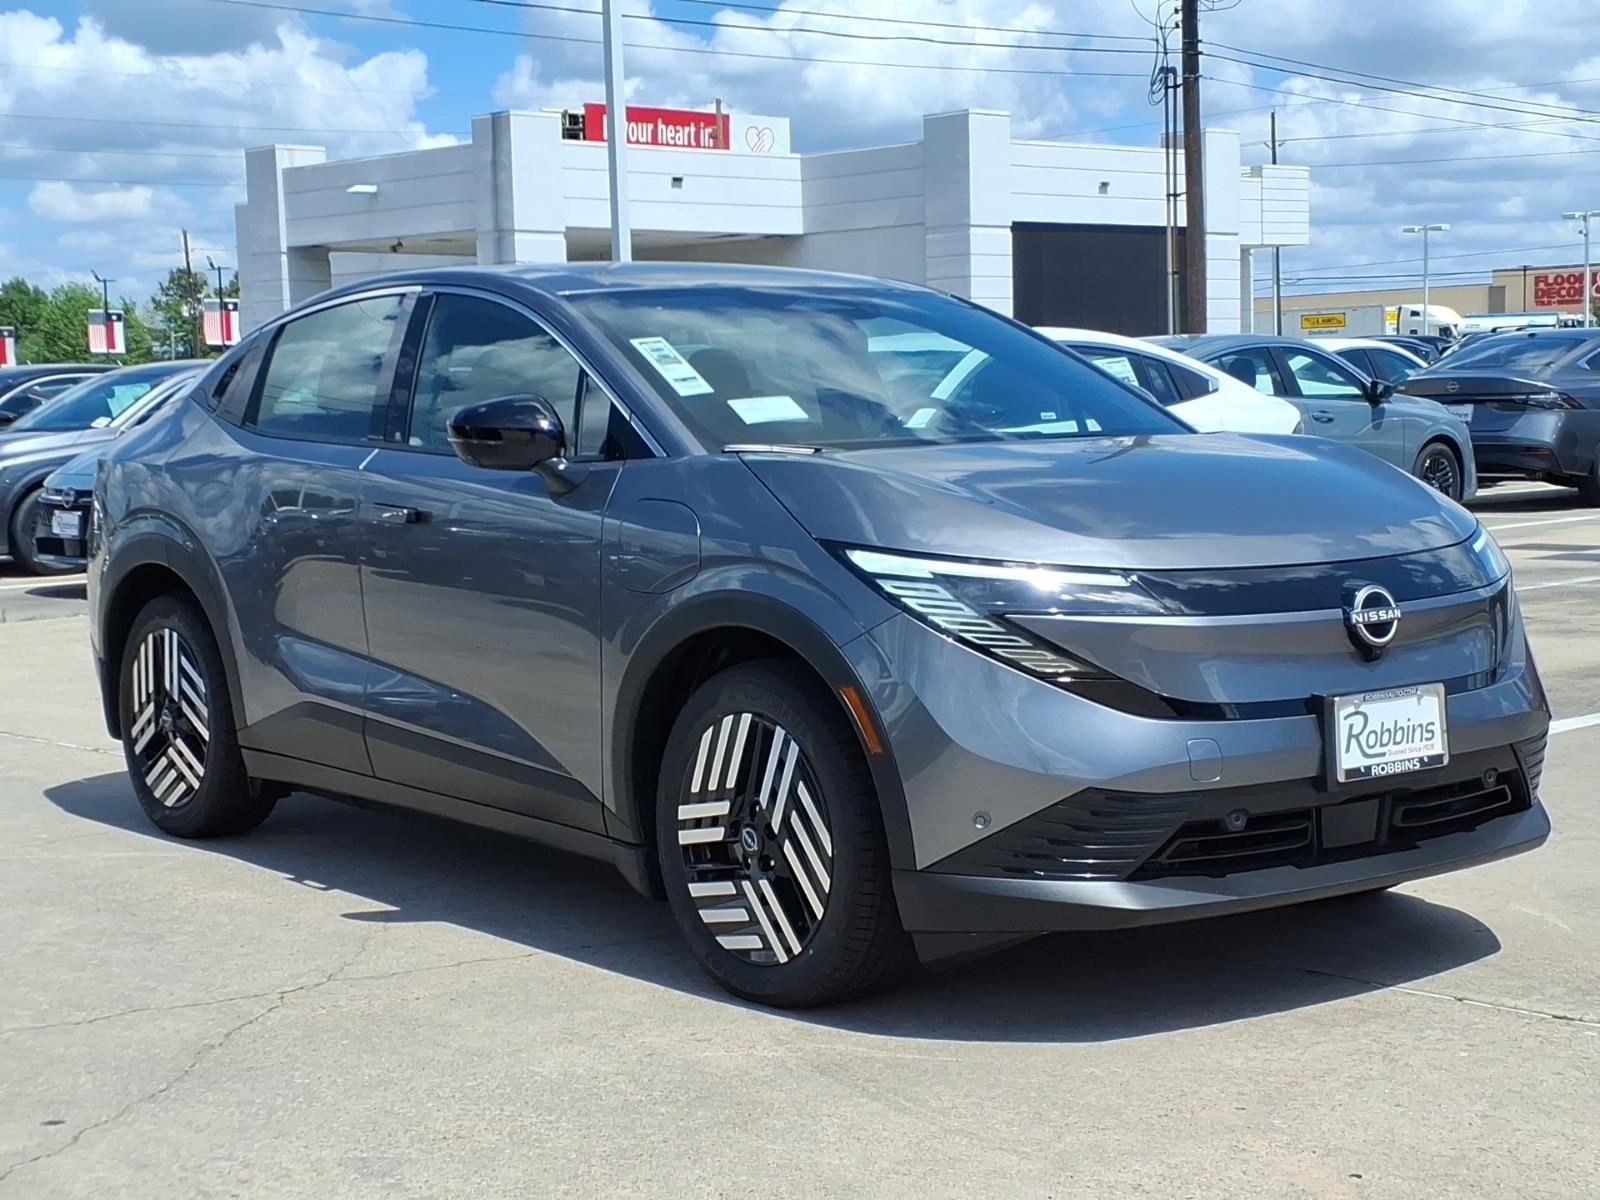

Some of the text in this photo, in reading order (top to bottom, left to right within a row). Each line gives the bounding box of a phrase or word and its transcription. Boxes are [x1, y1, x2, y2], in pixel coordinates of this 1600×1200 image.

[625, 121, 654, 143] our
[657, 117, 697, 146] heart
[1351, 608, 1401, 623] NISSAN
[1343, 711, 1435, 759] Robbins
[1371, 758, 1420, 776] ROBBINS
